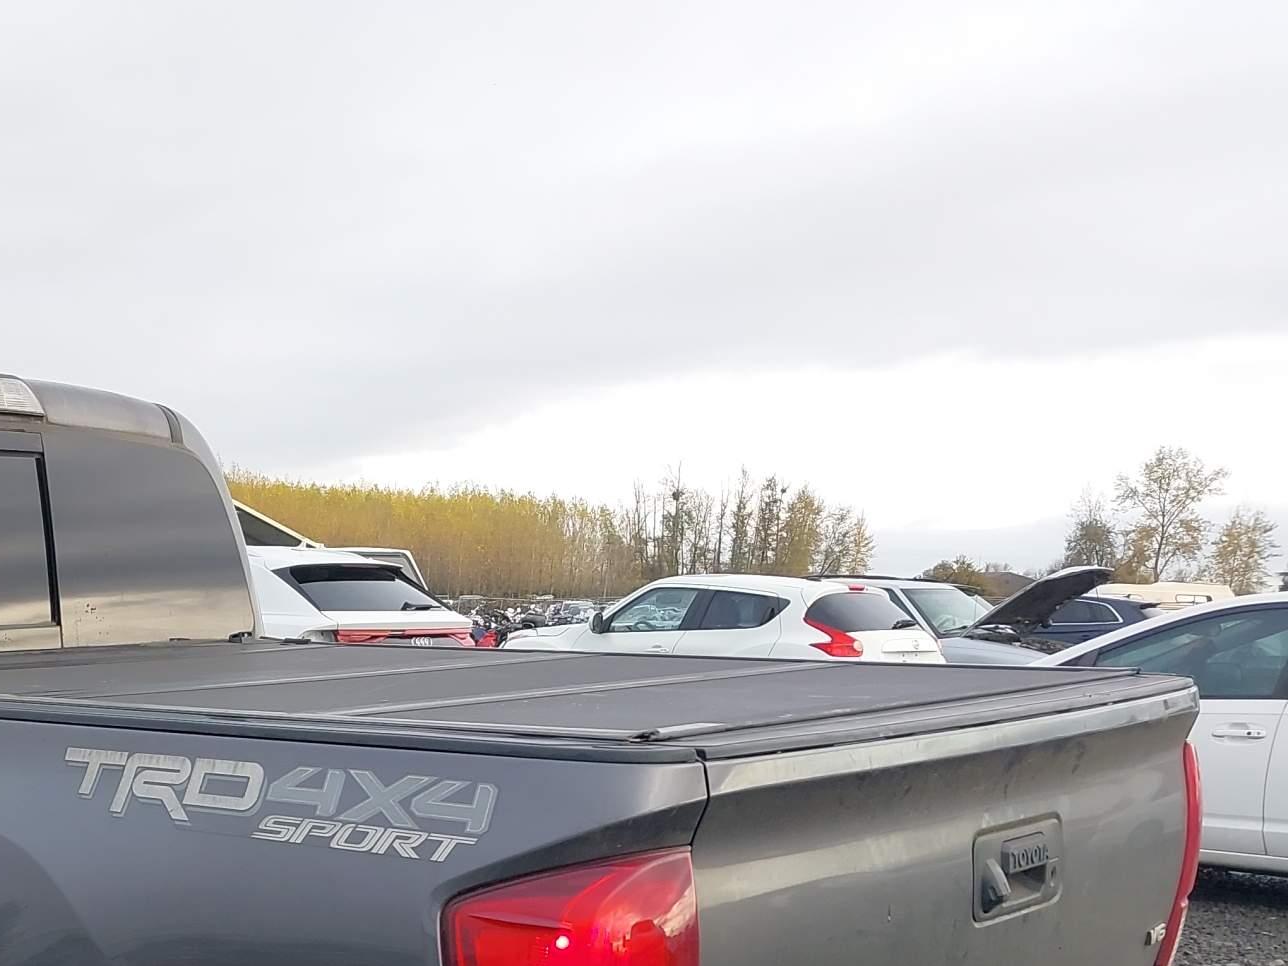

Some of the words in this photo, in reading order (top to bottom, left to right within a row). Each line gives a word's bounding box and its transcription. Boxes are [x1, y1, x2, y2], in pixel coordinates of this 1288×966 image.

[64, 747, 267, 824] TRD
[251, 815, 478, 862] SPORT
[1010, 843, 1049, 870] TOYOTA
[1145, 923, 1167, 946] V6
